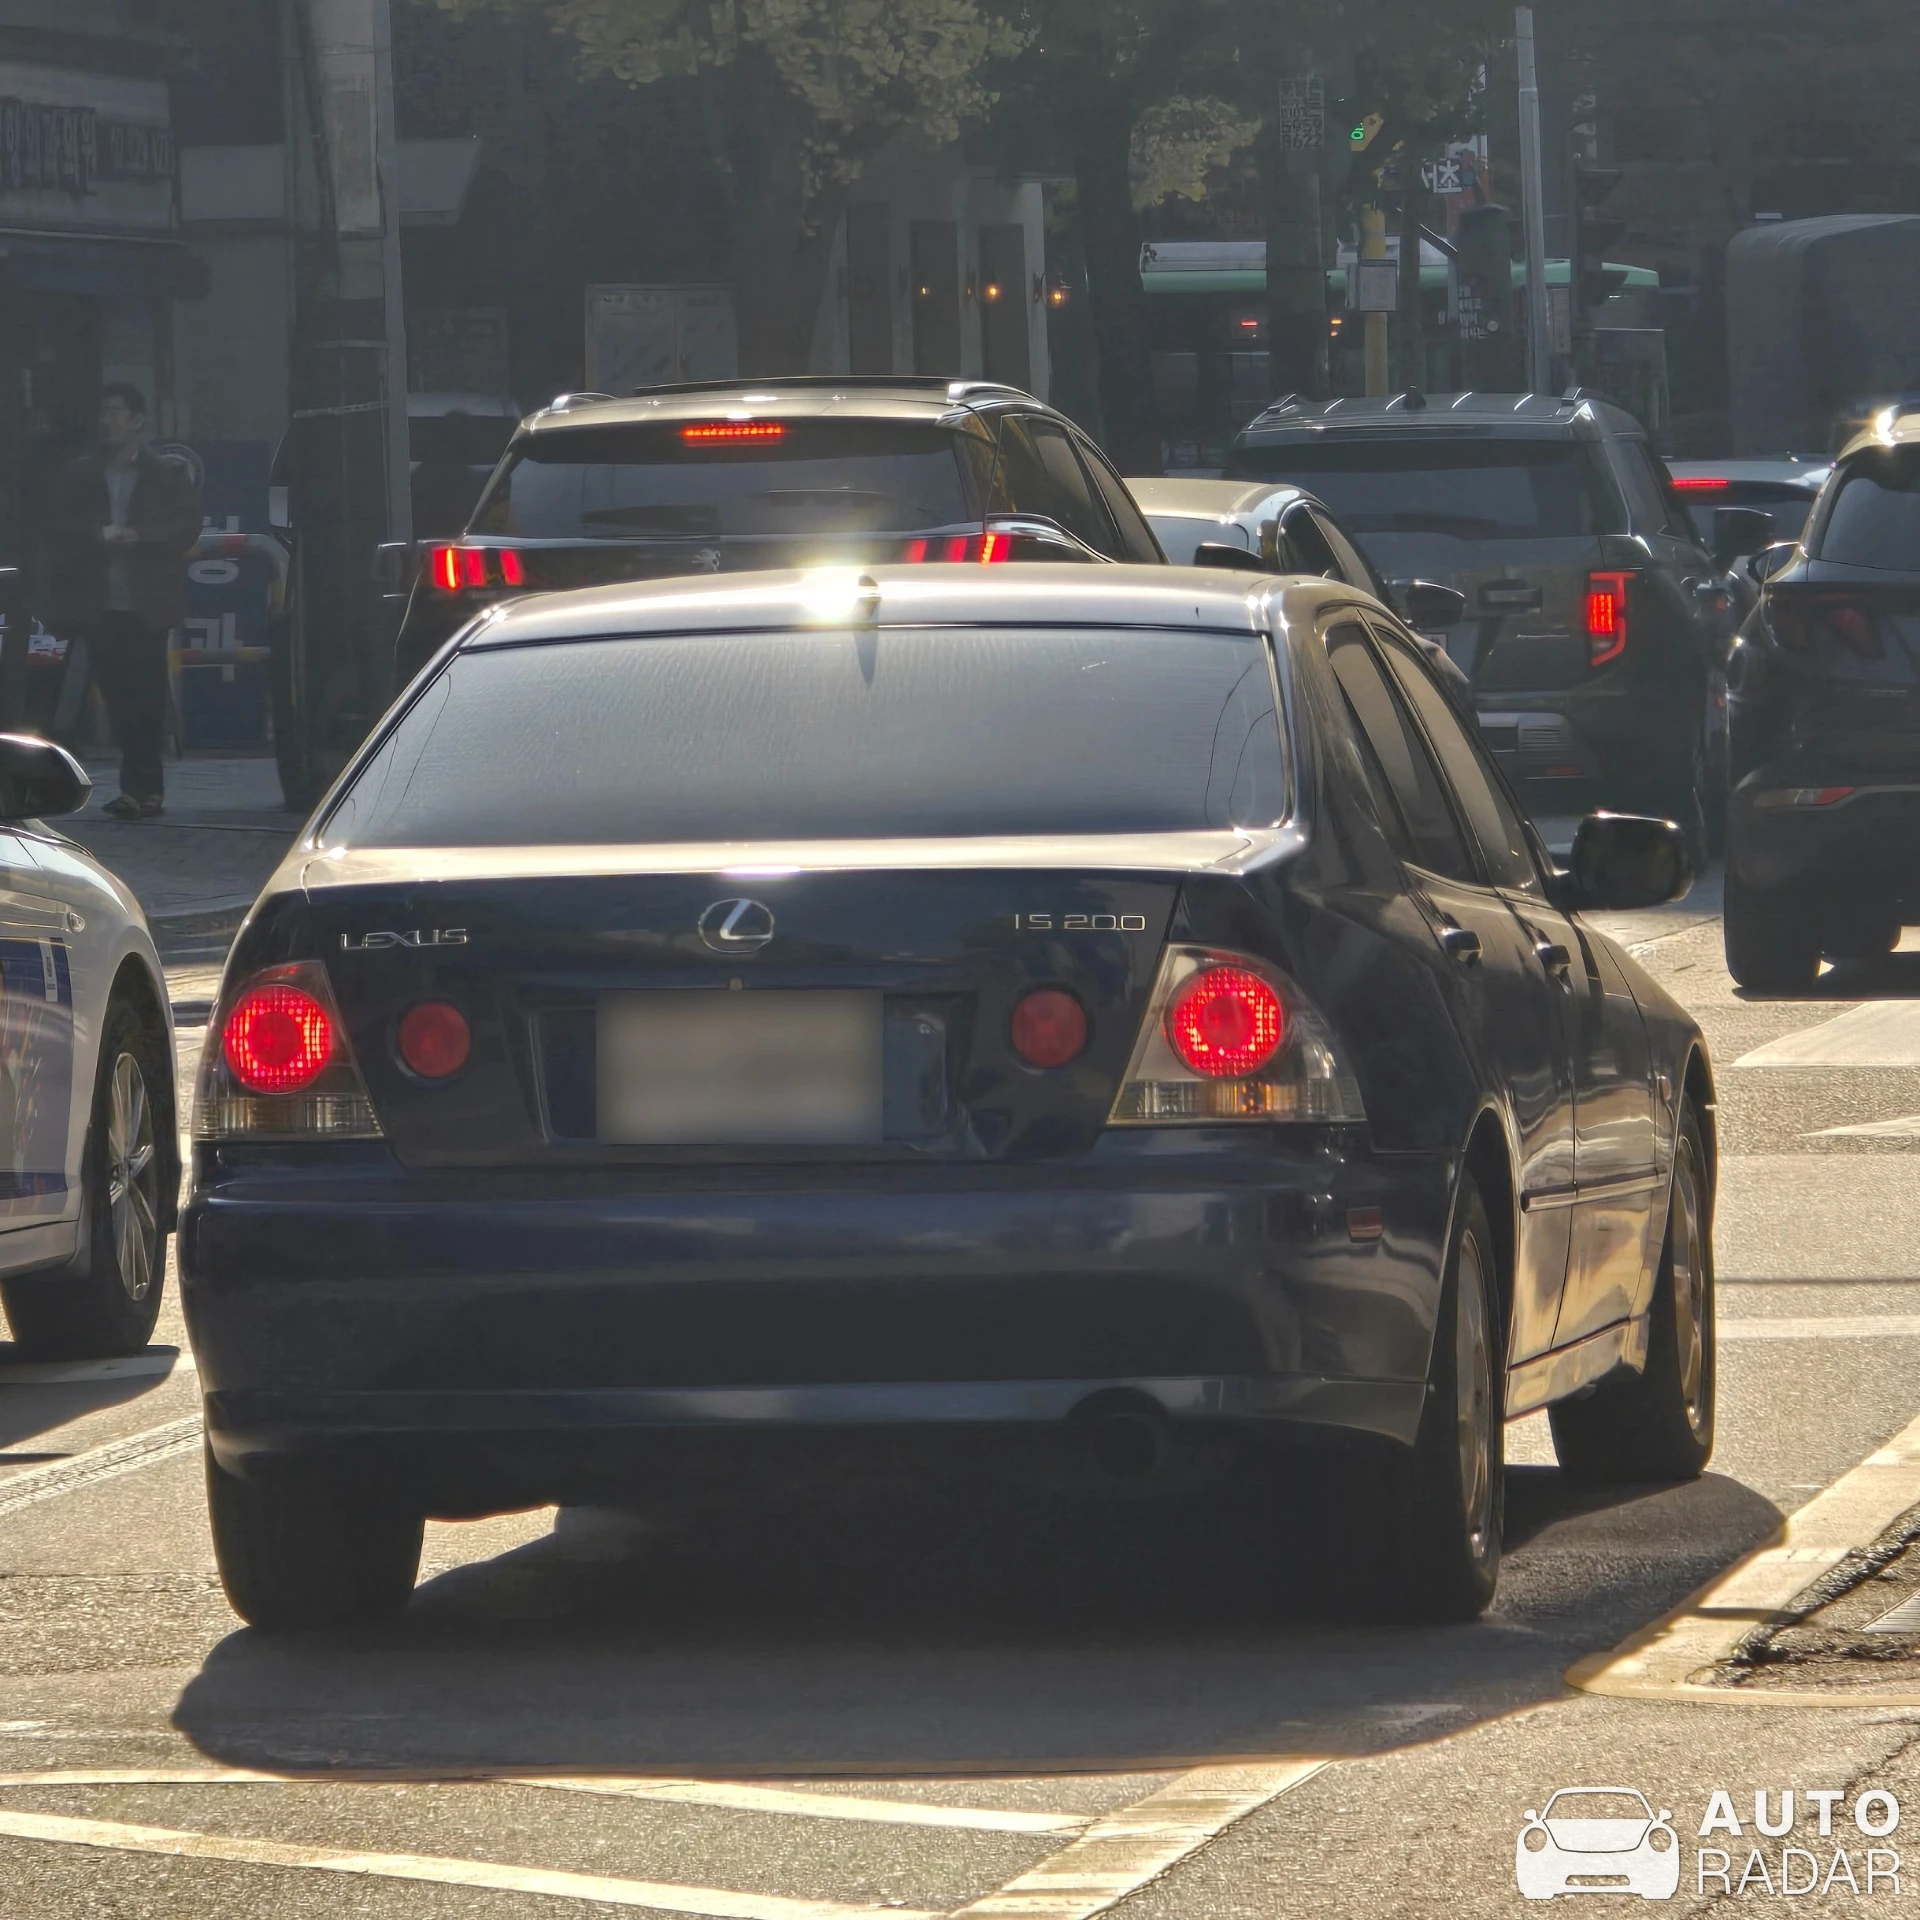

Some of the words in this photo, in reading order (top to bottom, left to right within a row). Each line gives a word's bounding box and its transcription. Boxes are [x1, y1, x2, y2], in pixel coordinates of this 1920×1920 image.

[1015, 914, 1052, 930] IS
[1063, 914, 1146, 931] 200
[340, 929, 469, 950] LEXUS
